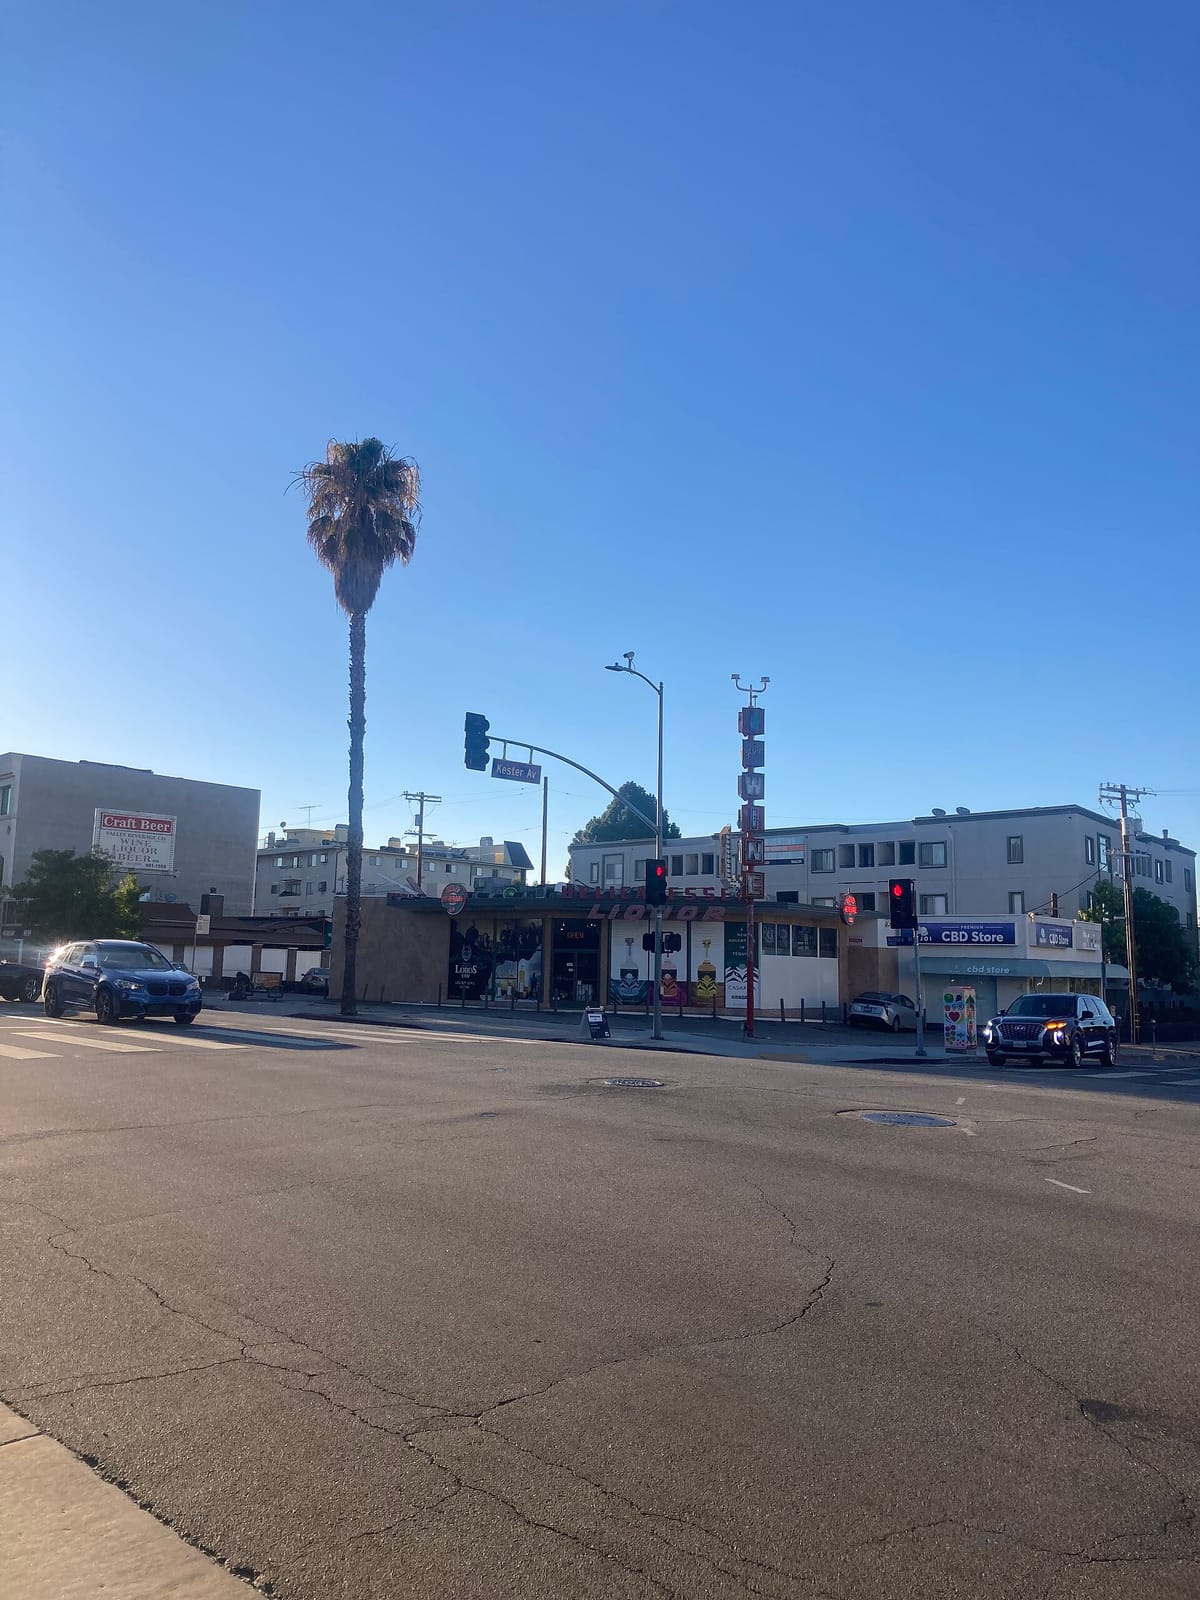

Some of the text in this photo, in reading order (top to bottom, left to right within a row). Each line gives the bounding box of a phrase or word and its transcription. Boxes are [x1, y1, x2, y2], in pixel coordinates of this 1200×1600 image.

[496, 764, 537, 779] Kester Av
[104, 816, 170, 831] Craft Beer
[120, 838, 151, 847] WINE
[116, 845, 158, 855] LIQUOR
[118, 853, 151, 863] BEER
[941, 930, 1004, 943] CBD Store
[966, 965, 985, 974] cbd
[986, 966, 1010, 974] store
